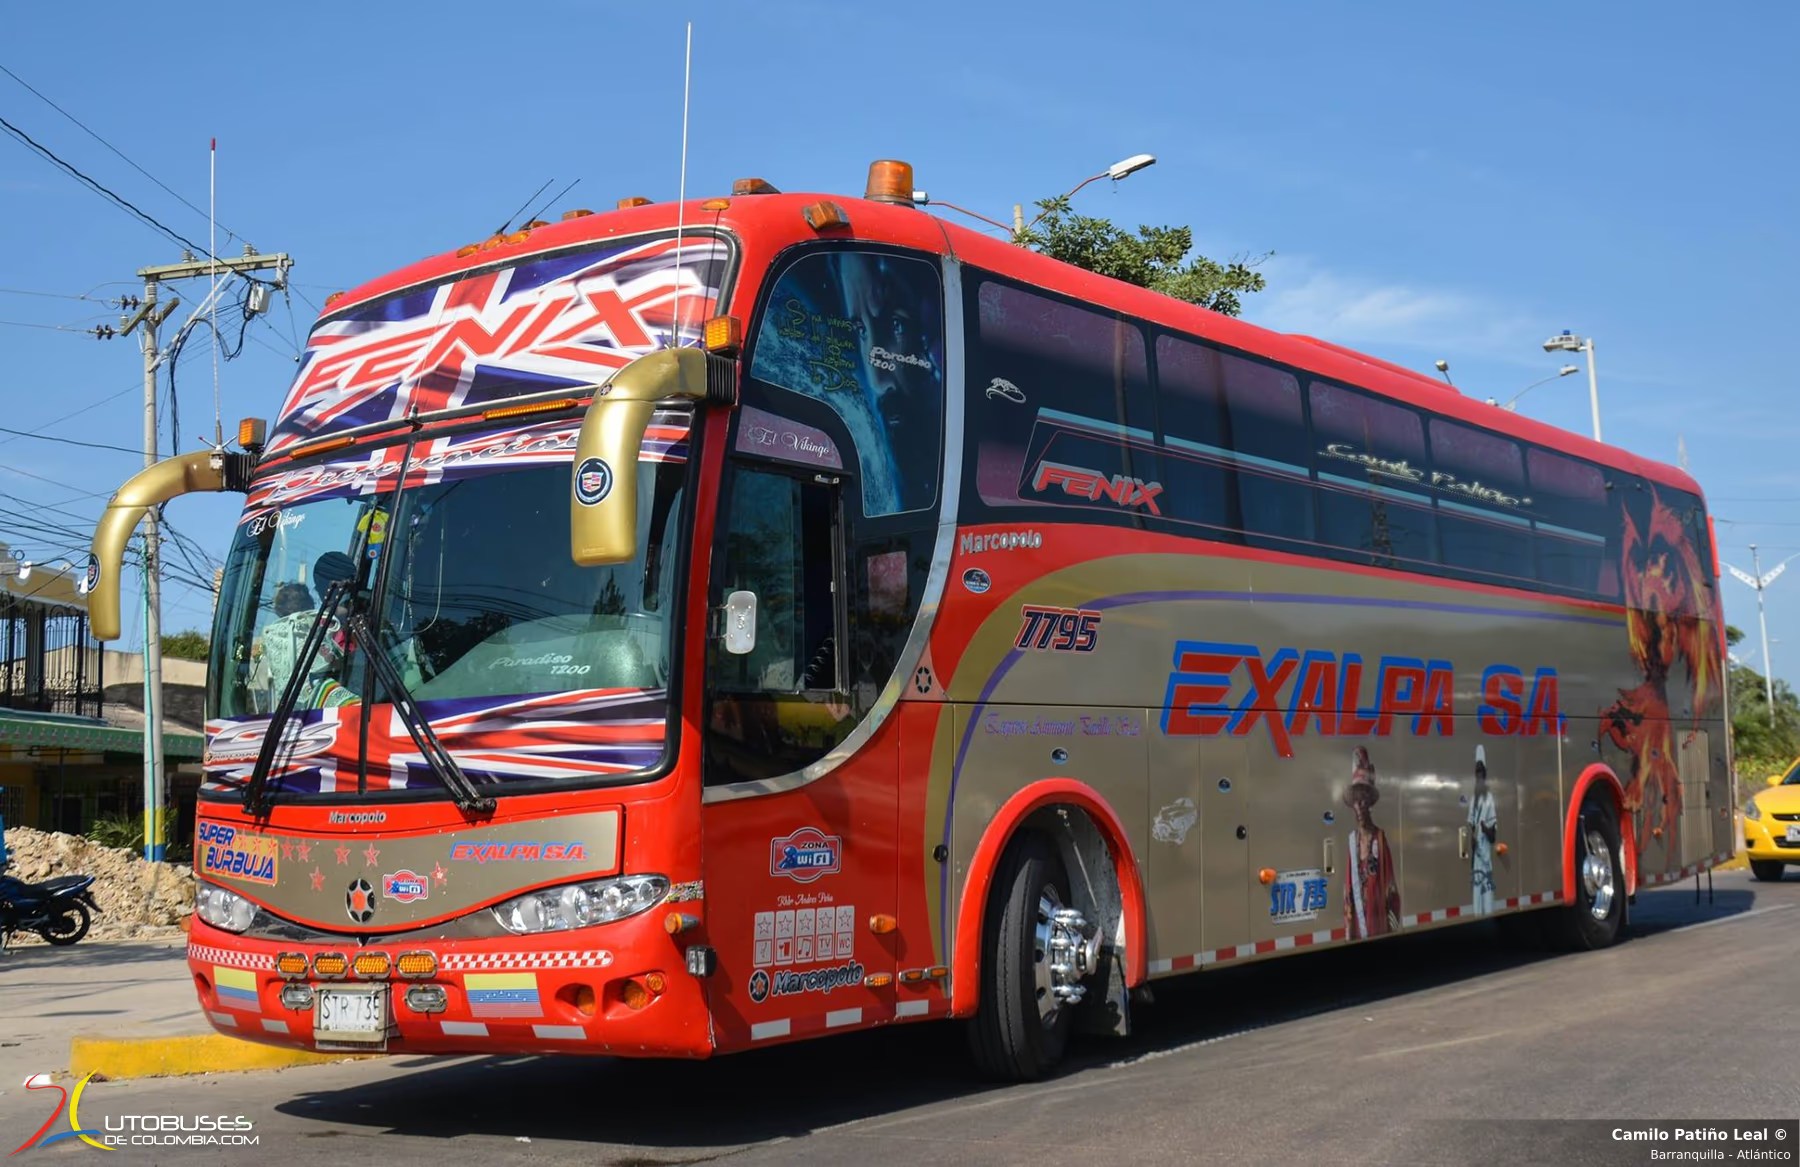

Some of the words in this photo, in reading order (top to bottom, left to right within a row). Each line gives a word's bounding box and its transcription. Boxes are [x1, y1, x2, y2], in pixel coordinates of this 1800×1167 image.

[278, 279, 701, 425] FENIX
[869, 345, 933, 369] Paradiso
[747, 426, 776, 446] El
[780, 431, 829, 458] Vikingo
[1032, 460, 1164, 516] FENIX
[267, 508, 306, 530] Vikingo
[959, 529, 1043, 556] Marcopolo
[1013, 603, 1103, 652] 7795
[487, 652, 574, 671] Paradiso
[1160, 639, 1455, 759] EXALPA
[1476, 664, 1570, 737] S.A.
[329, 811, 387, 825] Marcopolo
[198, 821, 238, 847] SUPER
[800, 841, 829, 850] ZONA
[205, 845, 277, 884] BURBUJA
[450, 840, 541, 864] EXALPA
[1270, 882, 1297, 916] STR
[818, 937, 832, 949] TV
[771, 960, 865, 996] Marcopolo
[322, 993, 349, 1020] STR
